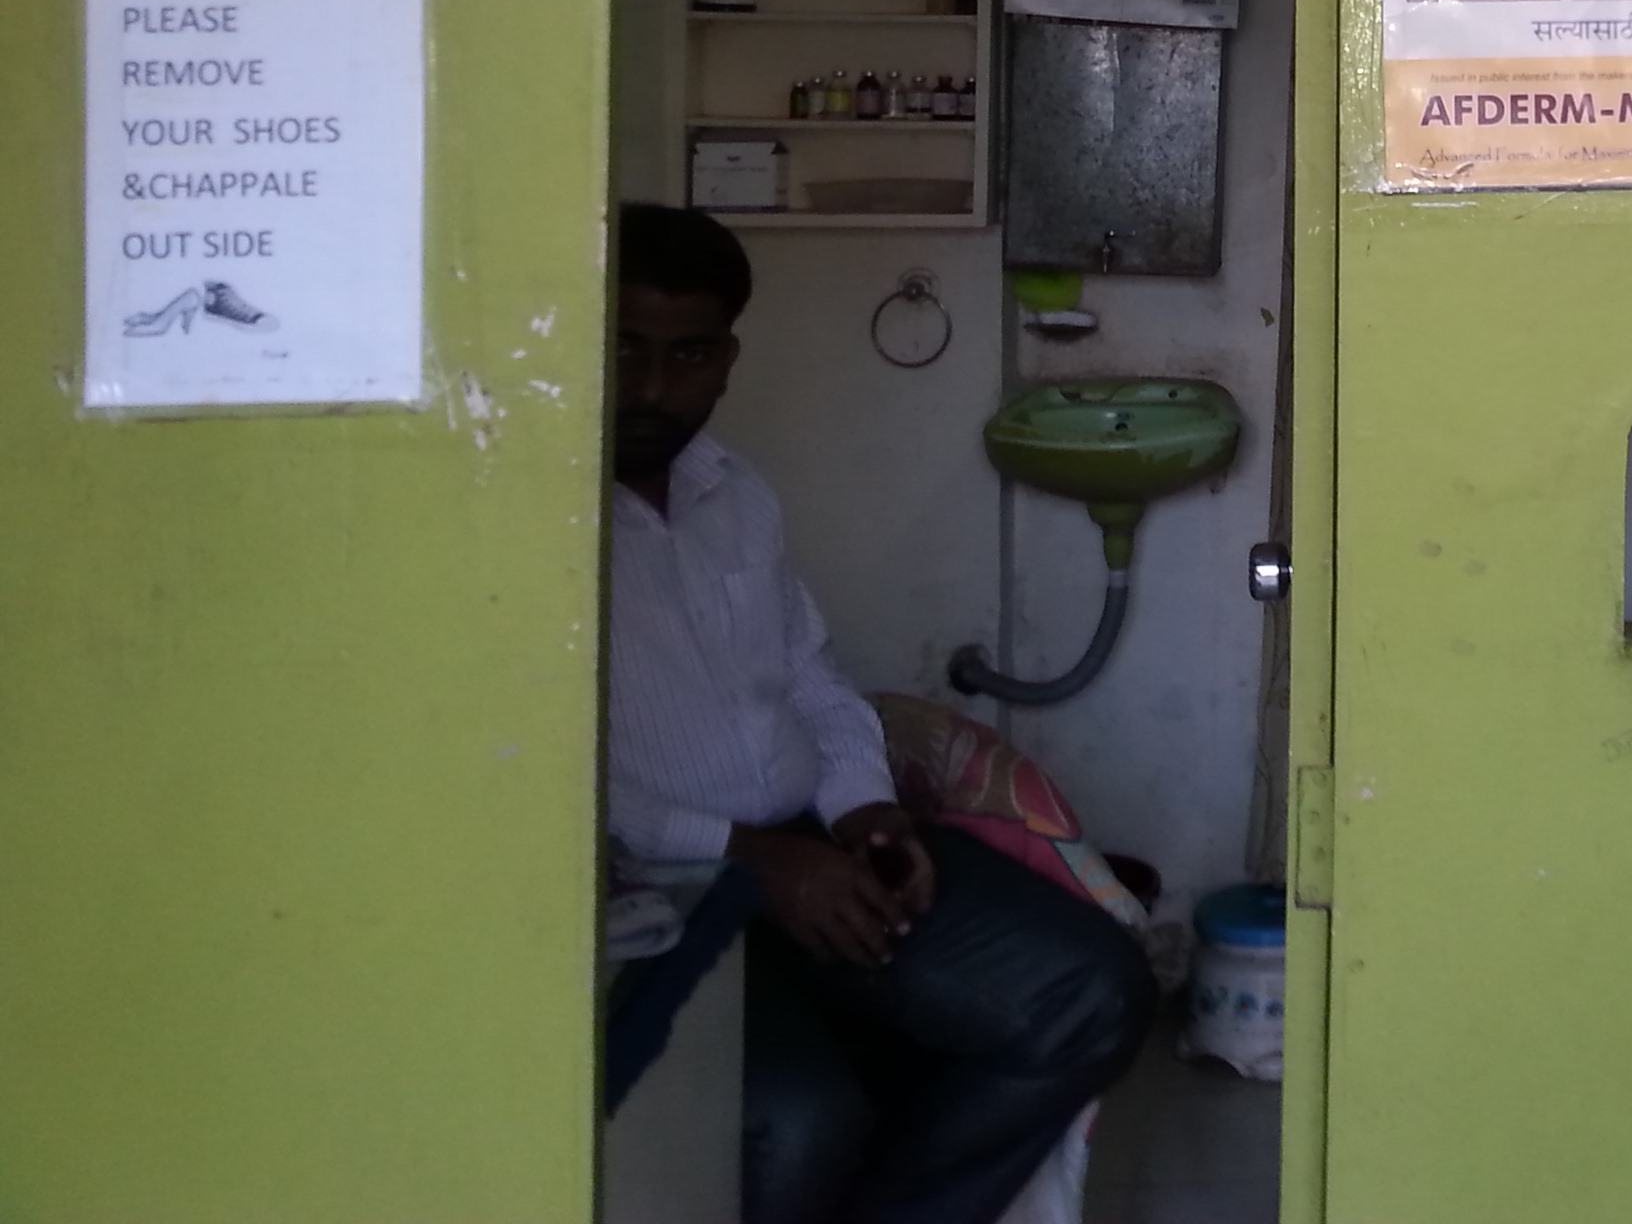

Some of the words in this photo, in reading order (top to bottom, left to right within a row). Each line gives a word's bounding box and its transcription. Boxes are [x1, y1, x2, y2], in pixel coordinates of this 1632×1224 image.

[122, 5, 239, 34] PLEASE
[122, 59, 265, 87] REMOVE
[1479, 71, 1510, 84] public
[1512, 71, 1551, 82] interest
[122, 119, 214, 146] YOUR
[232, 117, 341, 144] SHOES
[122, 170, 319, 201] &CHAPPALE
[122, 232, 192, 260] OUT
[203, 231, 274, 258] SIDE
